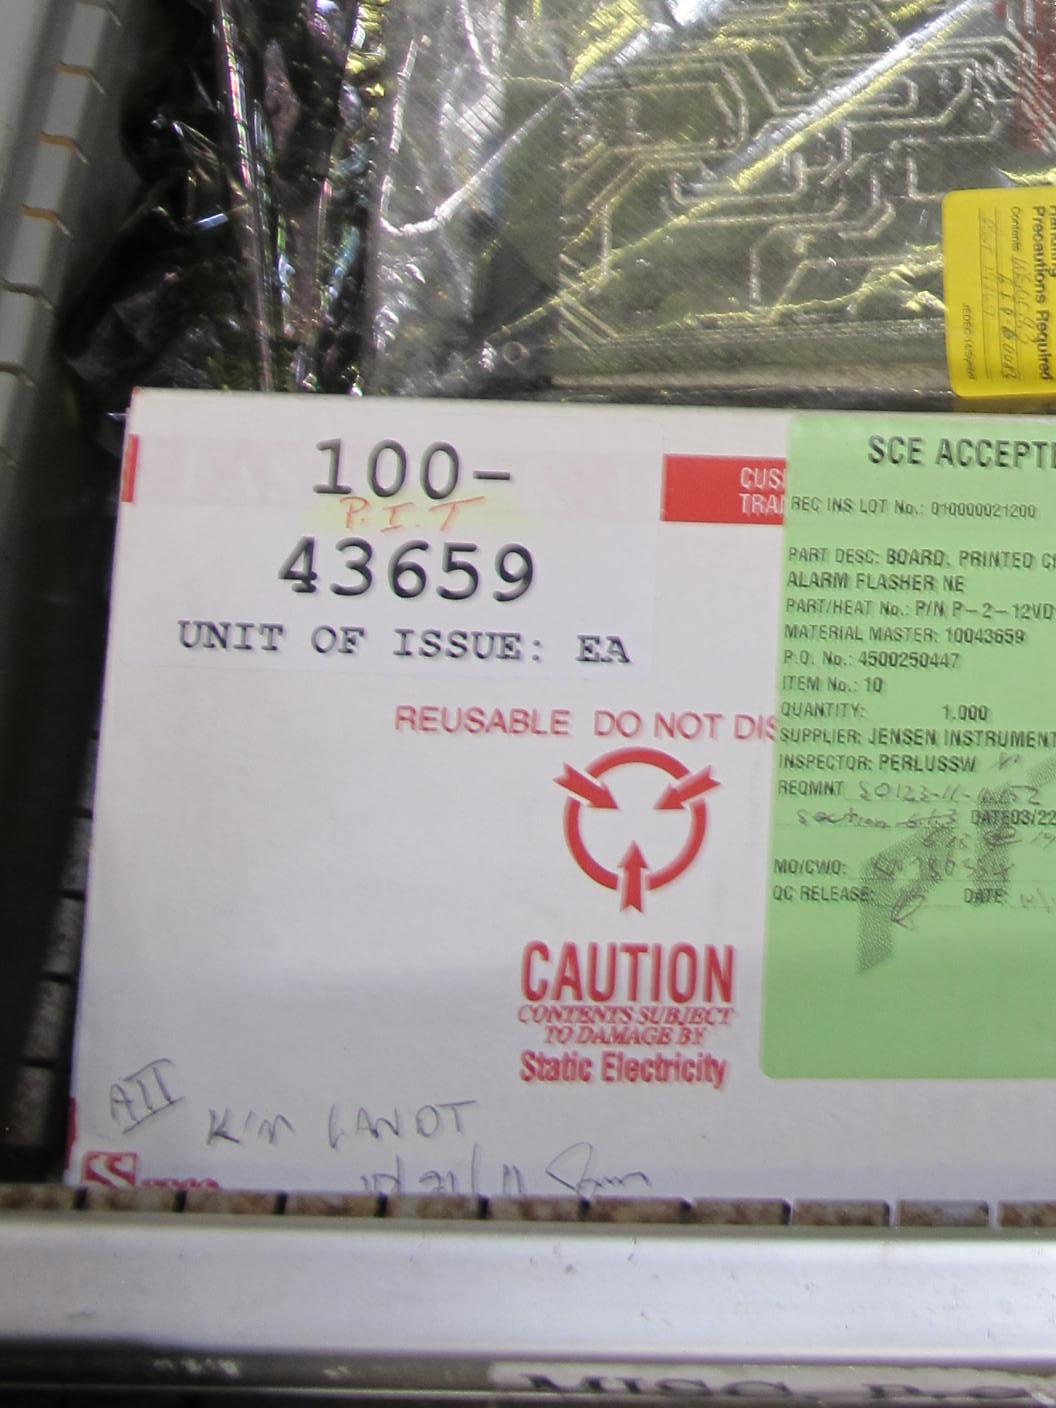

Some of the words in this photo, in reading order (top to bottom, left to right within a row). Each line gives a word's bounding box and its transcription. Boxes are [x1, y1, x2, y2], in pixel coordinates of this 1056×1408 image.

[1032, 205, 1047, 305] Precautions
[1035, 309, 1053, 382] Required
[867, 435, 922, 467] SCE
[313, 437, 512, 499] 100-
[740, 466, 785, 490] CUS
[739, 493, 785, 514] TRA
[791, 496, 821, 513] REC
[827, 498, 853, 515] INS
[859, 499, 888, 515] LOT
[788, 547, 827, 563] PART
[835, 548, 880, 565] DESC:
[959, 551, 1034, 570] PRINTED
[278, 537, 535, 603] 43659
[787, 573, 849, 590] ALARM
[856, 574, 935, 592] FLASHER
[943, 576, 966, 592] NE
[786, 600, 873, 617] PART/HEAT
[915, 602, 945, 619] P/N
[178, 620, 285, 652] UNIT
[311, 625, 366, 655] OF
[392, 628, 543, 662] ISSUE:
[577, 633, 632, 665] EA
[784, 625, 863, 642] MATERIAL
[869, 626, 938, 644] MASTER:
[945, 628, 1026, 645] 10043659
[858, 652, 961, 670] 4500250447
[782, 676, 820, 692] ITEM
[863, 677, 884, 693] 10
[780, 702, 864, 719] QUANTITY:
[942, 704, 989, 720] 1.000
[395, 705, 571, 737] REUSABLE
[594, 708, 643, 739] DO
[655, 711, 723, 740] NOT
[779, 728, 862, 745] SUPPLIER:
[868, 729, 936, 747] JENSEN
[777, 754, 873, 771] INSPECTOR:
[879, 755, 977, 773] PERLUSSW
[772, 885, 796, 903] QC
[520, 940, 736, 1004] CAUTION
[517, 1003, 634, 1024] CONTENTS
[637, 1005, 736, 1026] SUBJECT
[544, 1025, 574, 1044] TO
[577, 1026, 674, 1046] DAMAGE
[675, 1027, 708, 1047] BY
[519, 1048, 594, 1082] Static
[600, 1050, 728, 1090] Electricity
